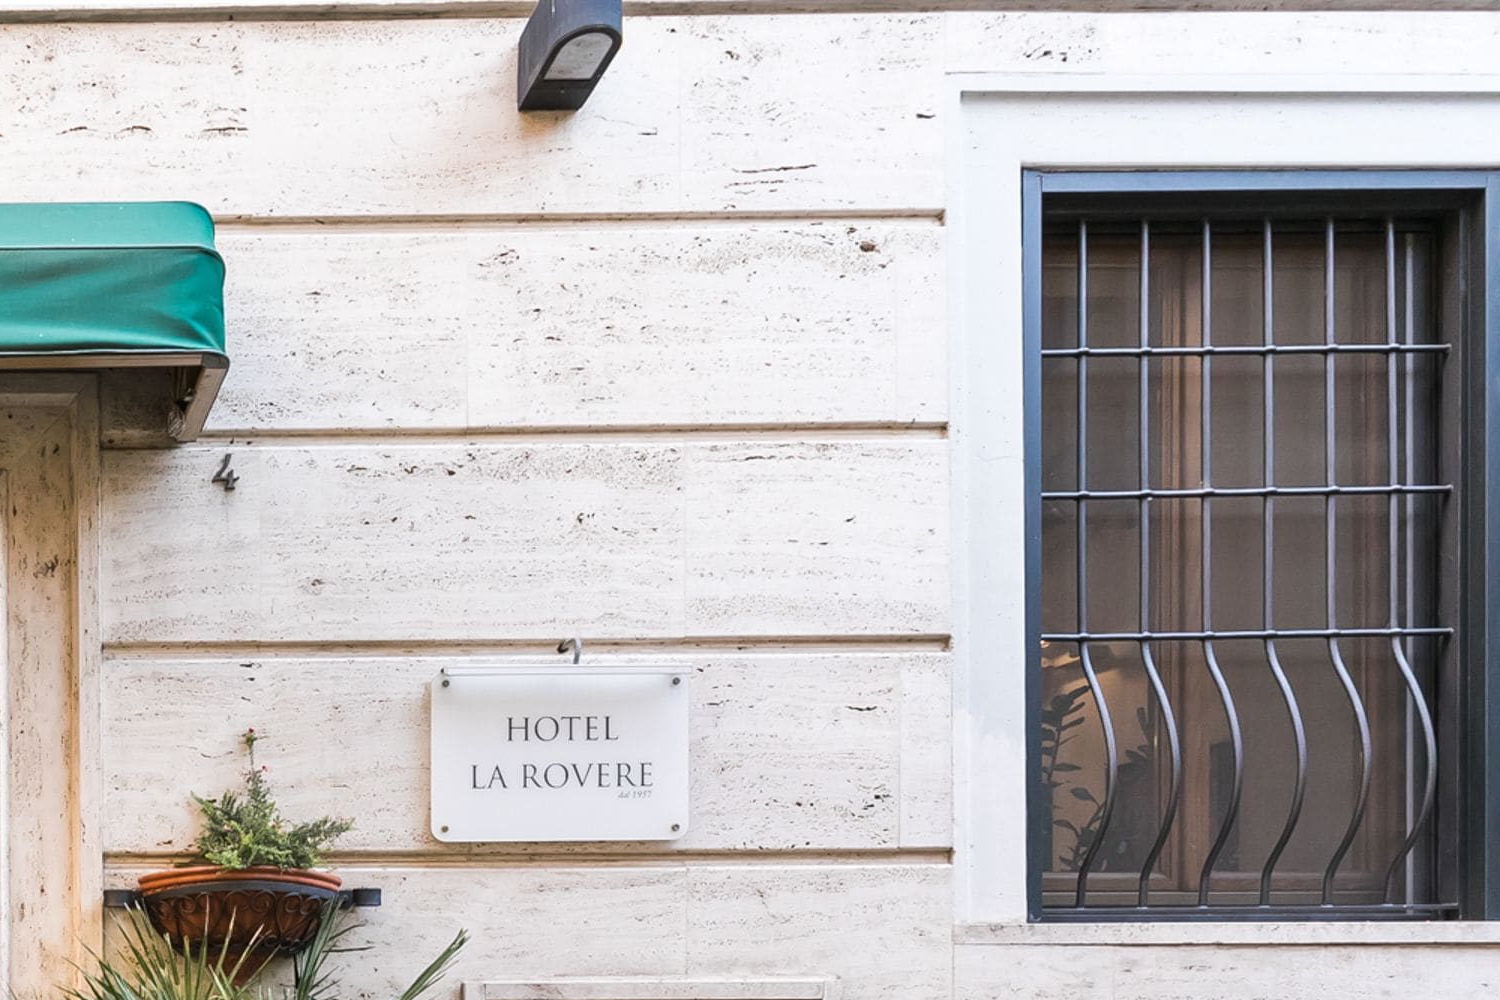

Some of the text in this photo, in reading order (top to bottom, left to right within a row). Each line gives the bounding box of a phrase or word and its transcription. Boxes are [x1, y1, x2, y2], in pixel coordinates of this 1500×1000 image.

[212, 453, 240, 491] 4
[506, 715, 620, 742] HOTEL
[470, 761, 655, 790] LA ROVERE
[632, 790, 652, 800] 1957
